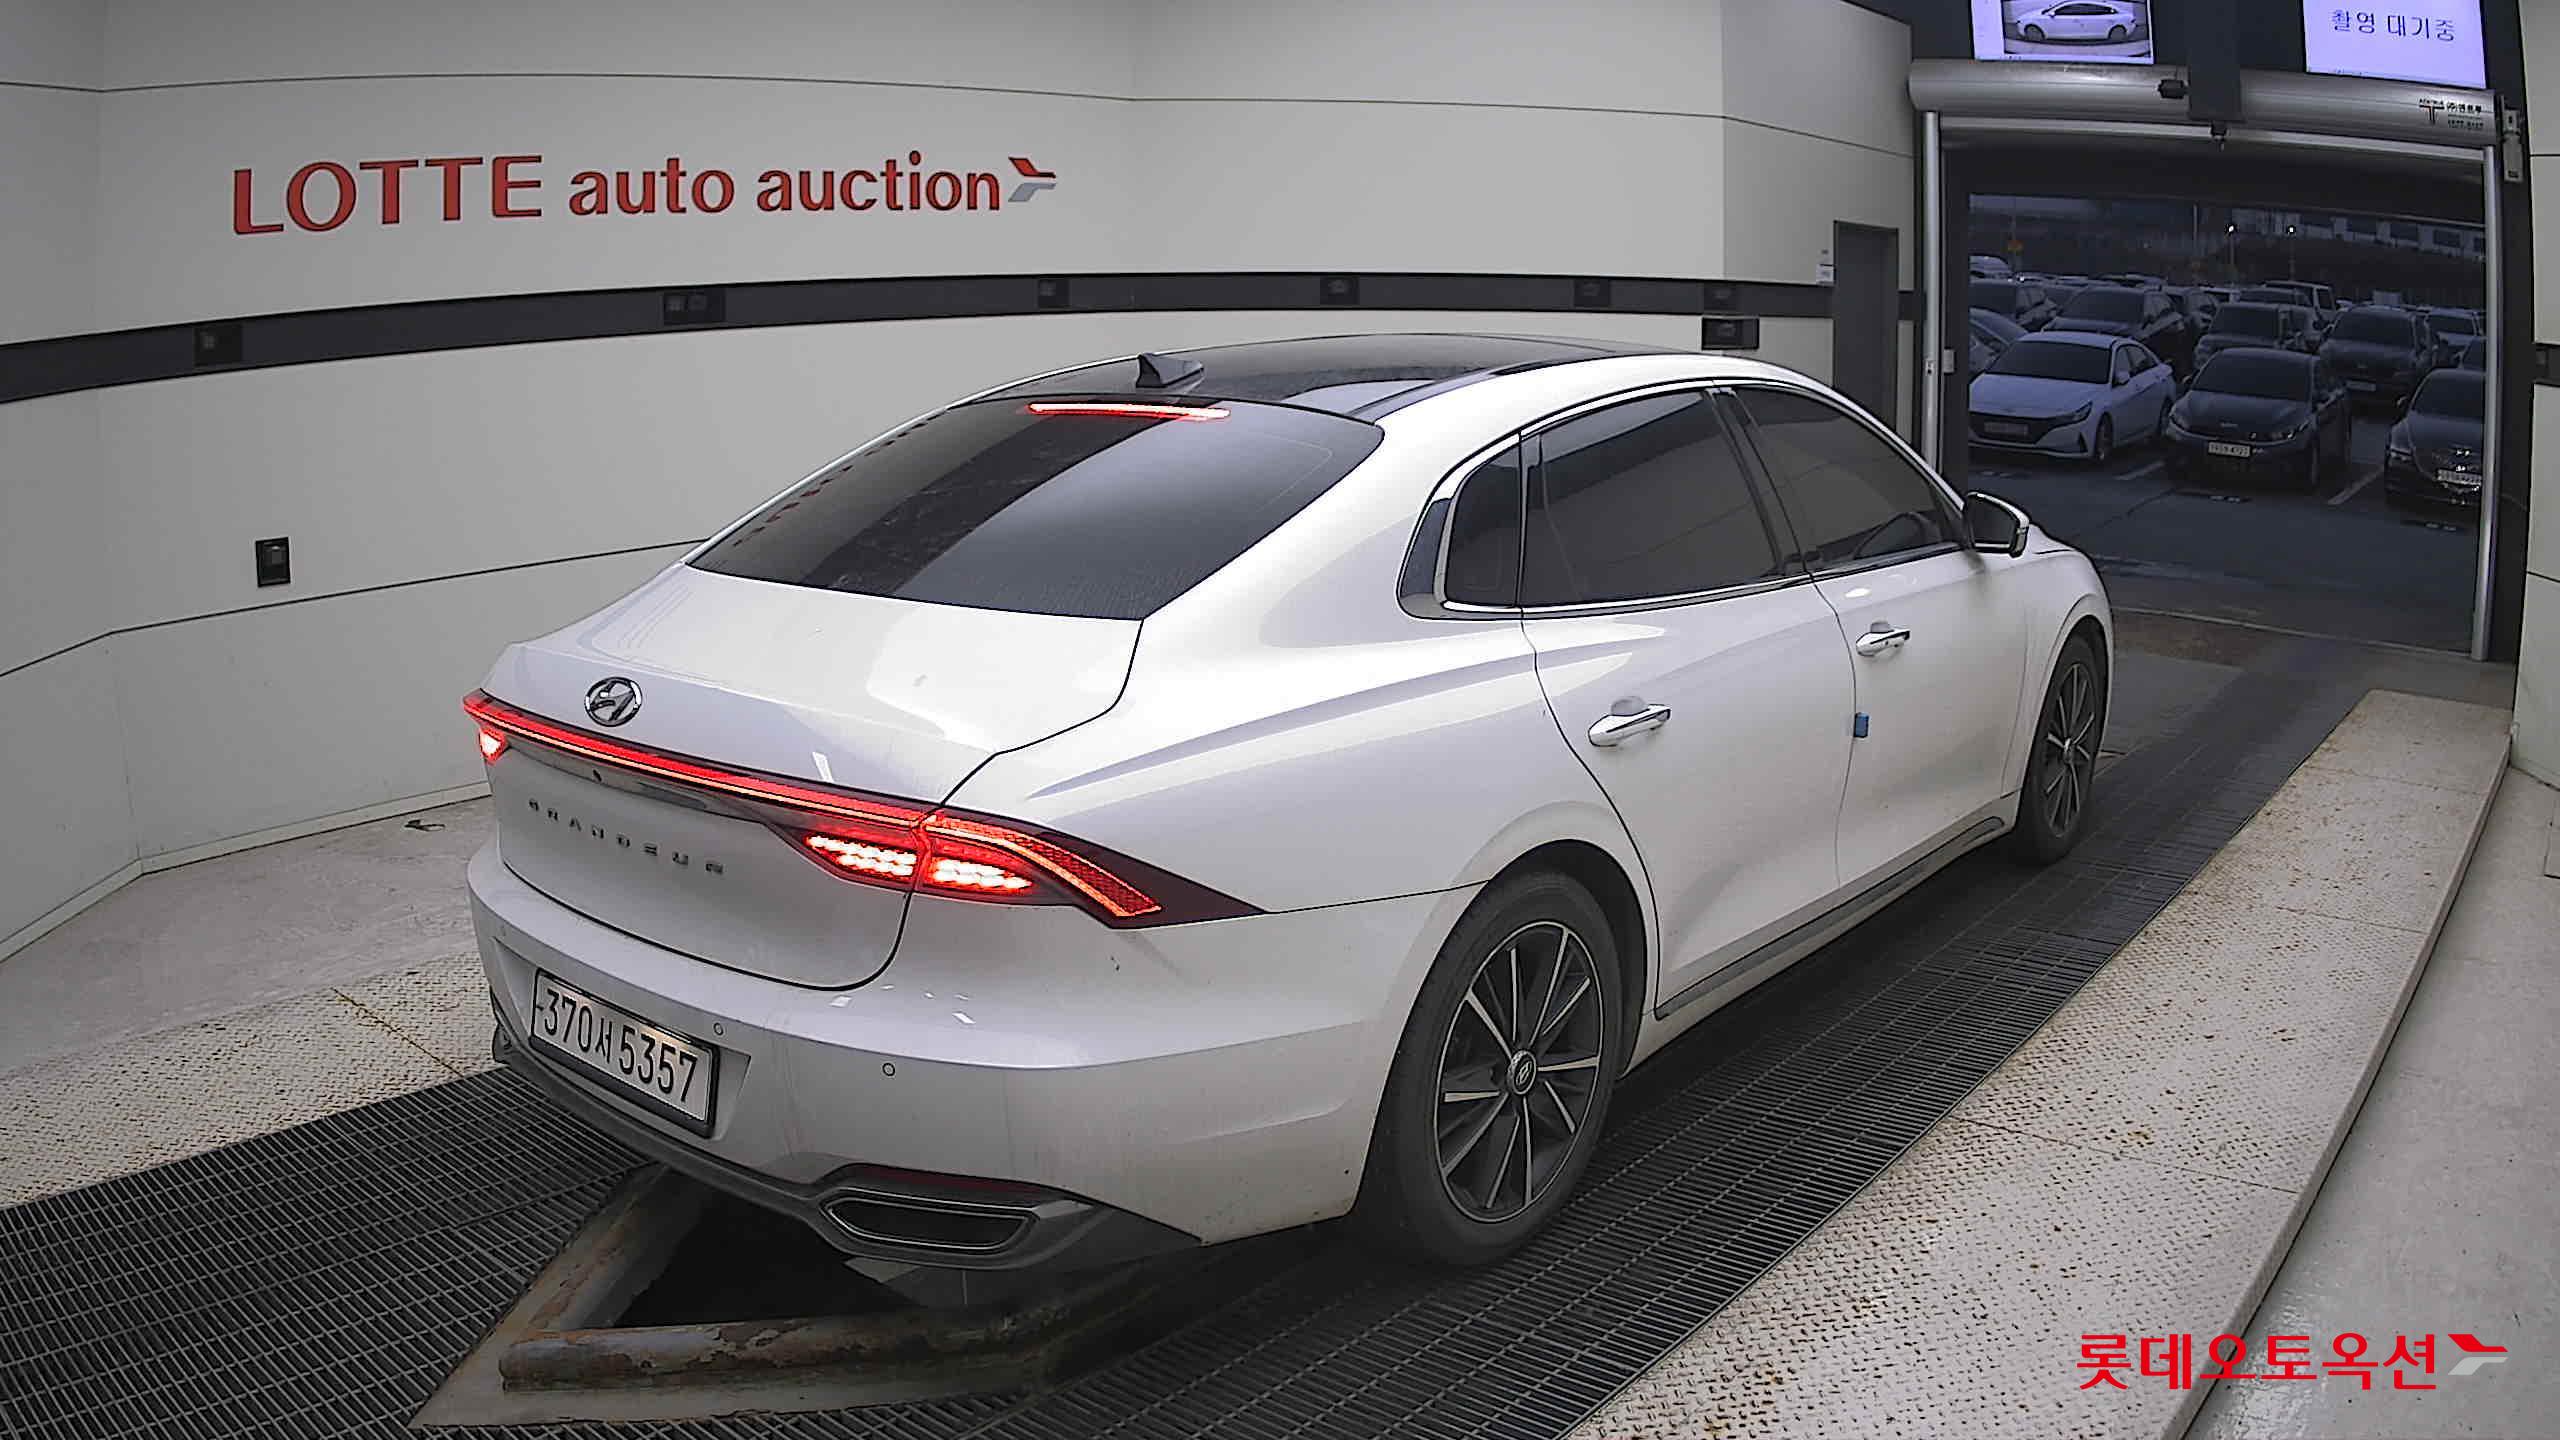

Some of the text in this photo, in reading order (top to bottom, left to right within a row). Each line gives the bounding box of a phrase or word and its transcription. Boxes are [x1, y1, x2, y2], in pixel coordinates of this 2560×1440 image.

[2330, 9, 2455, 42] 촬영 대기중
[233, 150, 1001, 235] LOTTE auto auction
